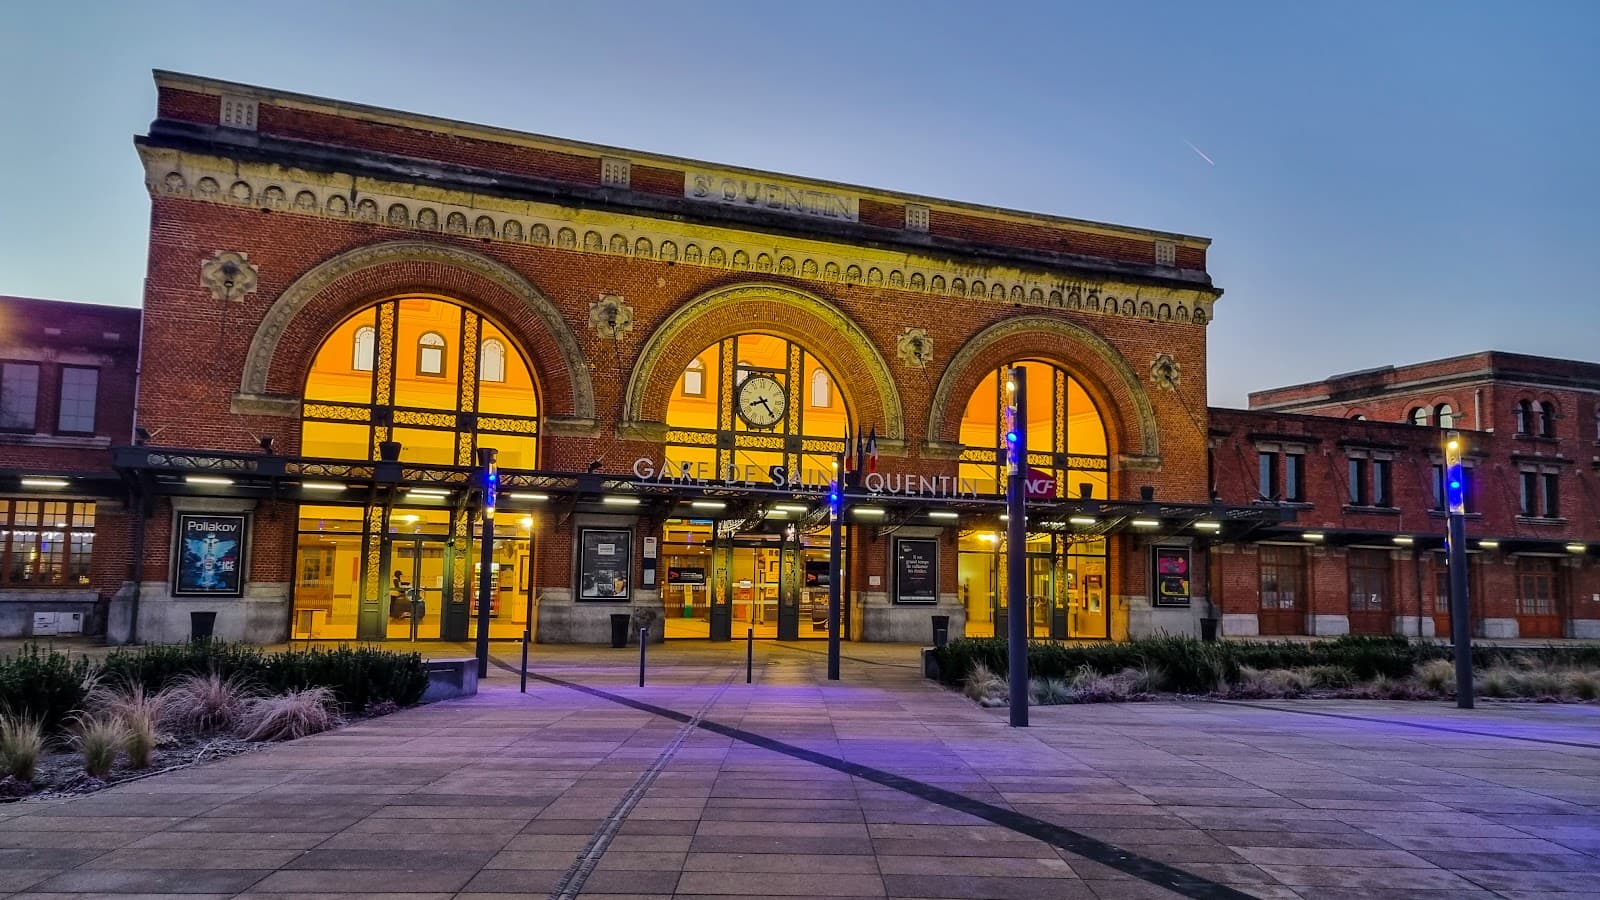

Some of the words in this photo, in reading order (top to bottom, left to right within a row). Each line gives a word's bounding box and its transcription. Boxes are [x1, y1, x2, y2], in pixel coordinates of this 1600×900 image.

[720, 178, 853, 219] QUENTIN
[633, 458, 708, 482] GARE
[725, 463, 756, 485] DE
[865, 473, 977, 497] QUENTIN
[1024, 479, 1056, 494] NCF
[188, 521, 237, 532] Poliakov
